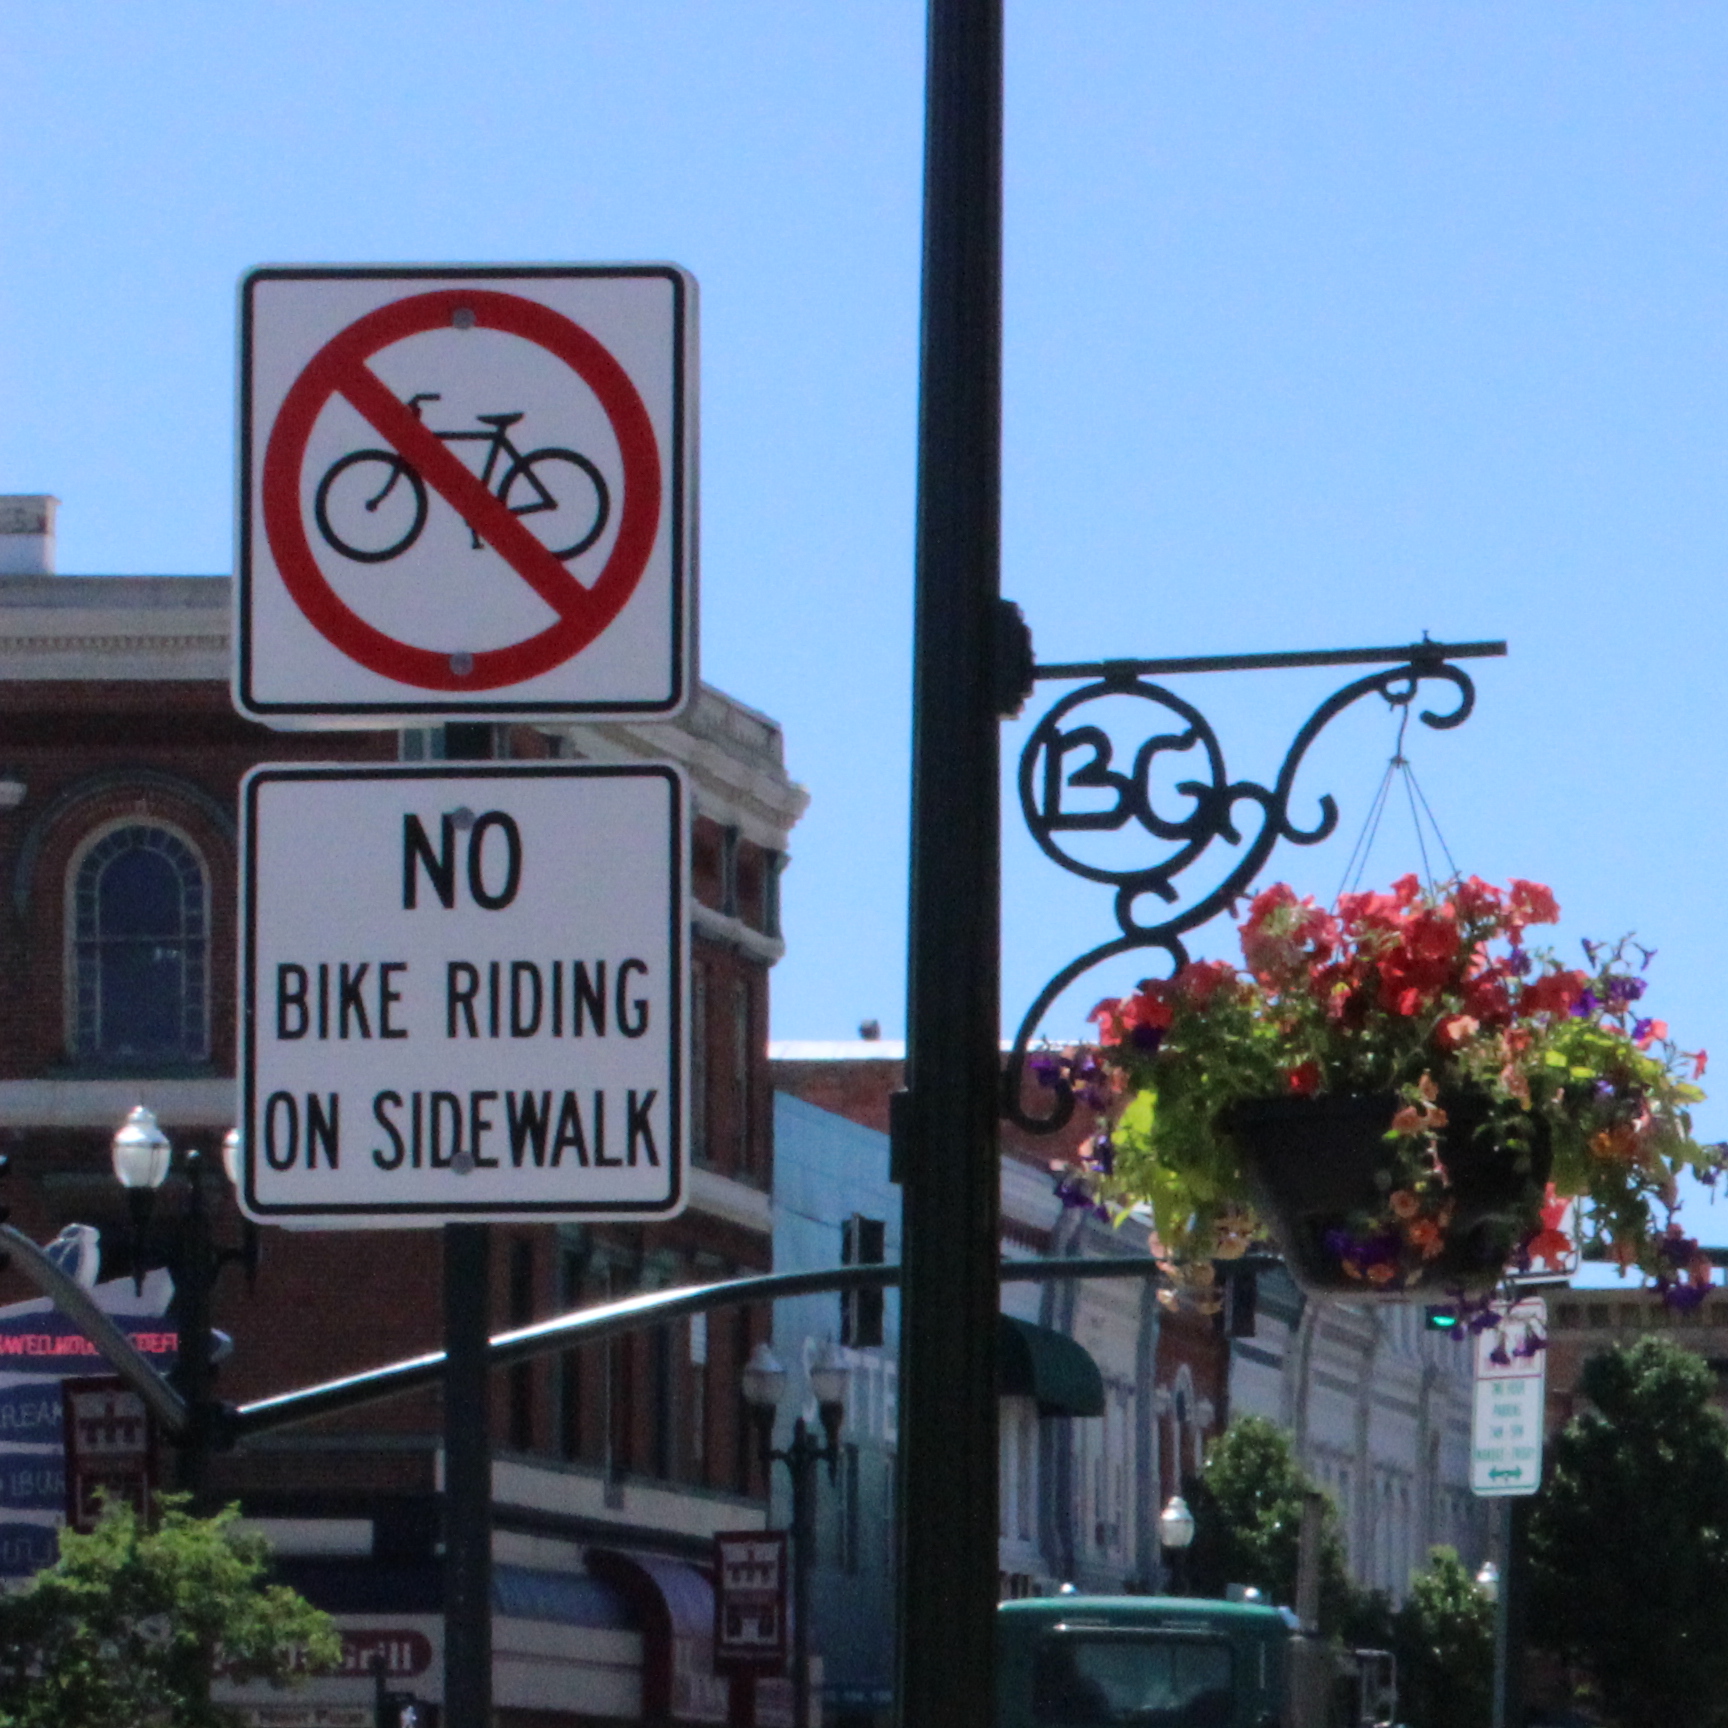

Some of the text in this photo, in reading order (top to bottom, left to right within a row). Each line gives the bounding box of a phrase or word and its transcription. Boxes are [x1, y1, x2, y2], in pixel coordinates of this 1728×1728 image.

[403, 811, 522, 911] NO
[276, 957, 650, 1040] BIKE RIDING
[264, 1089, 660, 1171] ON SIDEWALK
